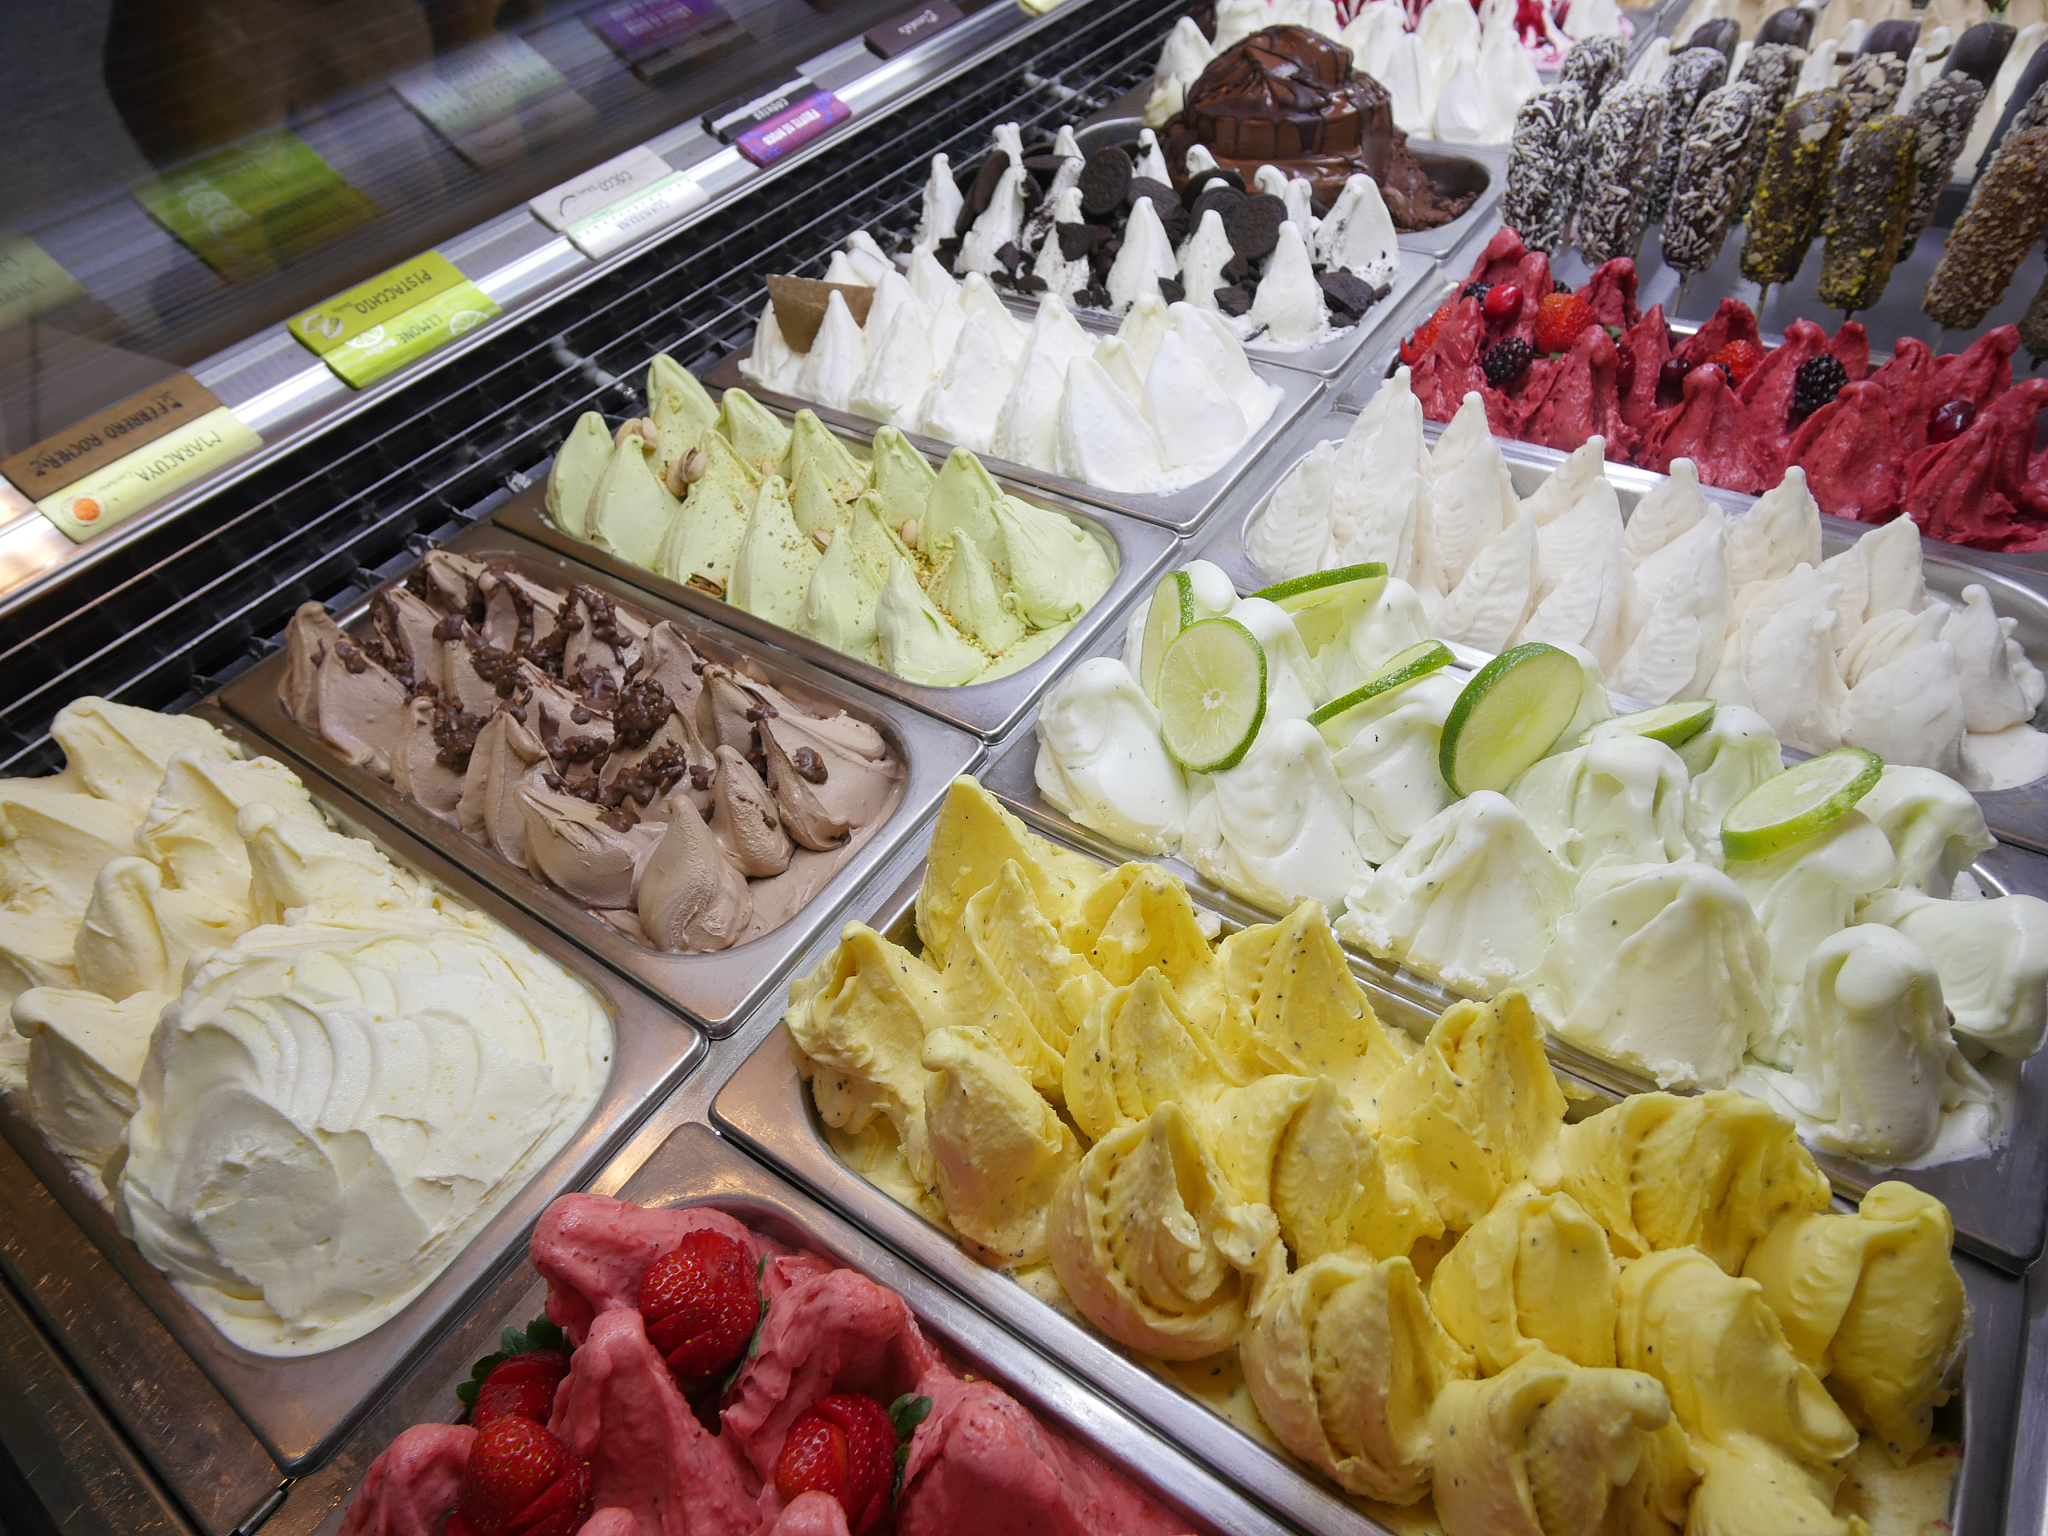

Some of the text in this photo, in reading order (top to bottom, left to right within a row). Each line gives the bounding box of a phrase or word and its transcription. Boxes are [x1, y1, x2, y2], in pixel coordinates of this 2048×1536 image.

[598, 169, 632, 192] COCCO
[354, 268, 432, 313] PISTACCHIO
[394, 312, 443, 344] LIMONE
[41, 399, 170, 471] FERRERO ROCHER
[134, 431, 221, 481] MARACUYA
